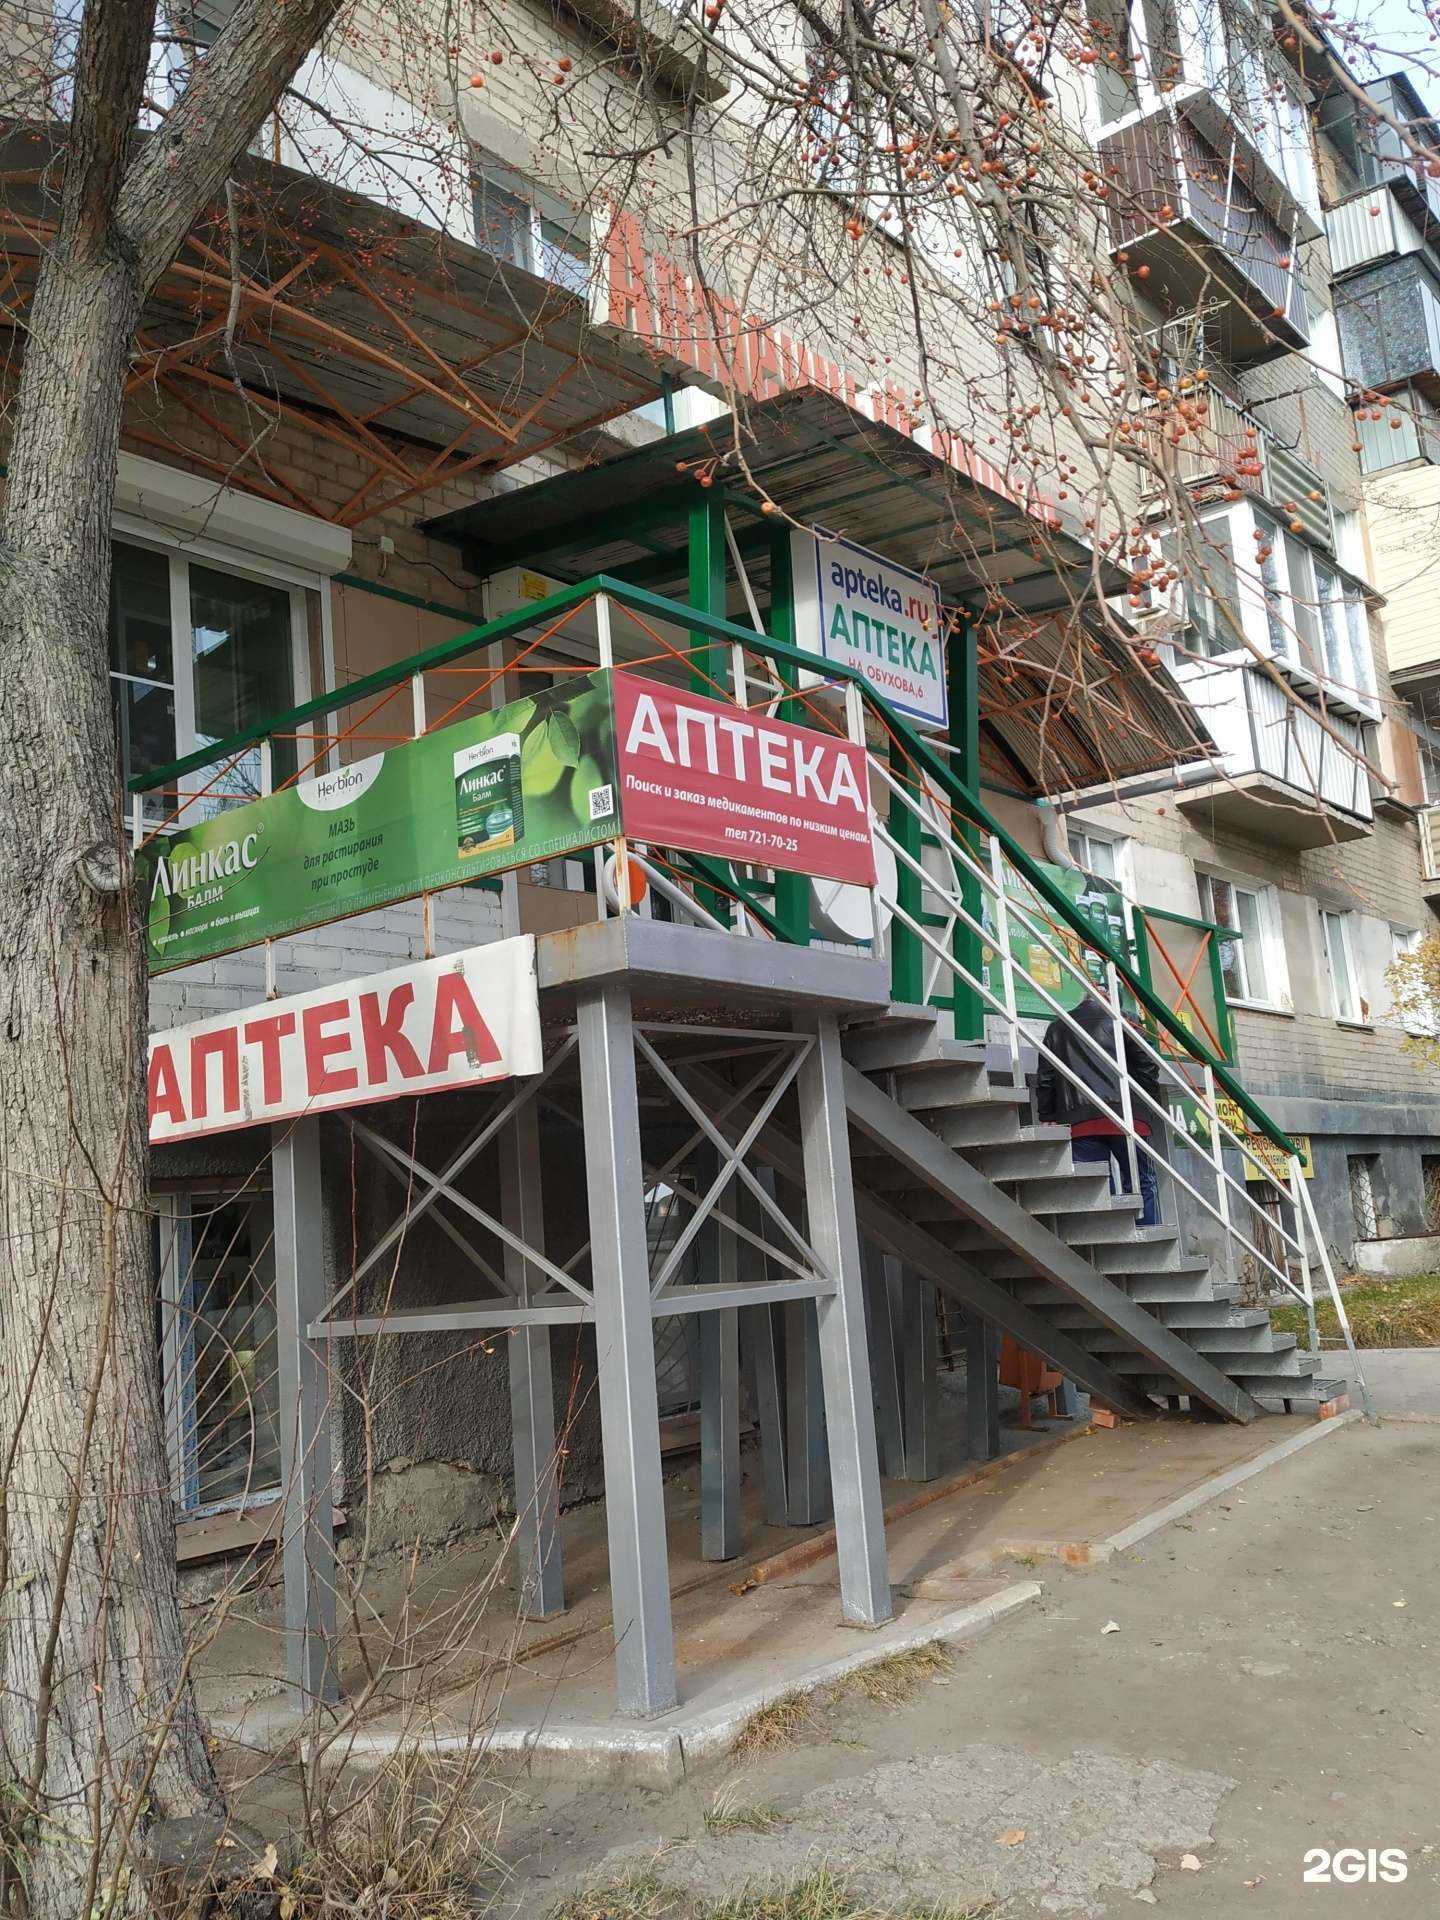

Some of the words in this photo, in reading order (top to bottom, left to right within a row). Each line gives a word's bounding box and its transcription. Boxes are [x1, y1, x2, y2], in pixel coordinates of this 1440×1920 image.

[831, 561, 929, 623] apteka.ru
[830, 603, 937, 680] АПТЕКА
[867, 665, 924, 698] ОБУХОВА,6
[625, 693, 866, 812] АПТЕКА
[317, 770, 363, 798] Herbion
[460, 768, 504, 795] Линкас
[472, 790, 492, 802] Балм
[626, 774, 662, 796] Поиск
[664, 786, 672, 797] и
[673, 788, 706, 805] заказ
[707, 796, 788, 824] медикаментов
[789, 816, 801, 827] по
[803, 820, 838, 836] низким
[839, 828, 870, 844] ценам.
[328, 818, 356, 838] МАЗЬ
[724, 826, 748, 841] тел
[749, 829, 798, 852] 721-70-25
[303, 855, 321, 870] для
[321, 833, 384, 867] растирания
[311, 876, 329, 892] при
[330, 857, 380, 887] простуде
[149, 972, 502, 1128] АПТЕКА
